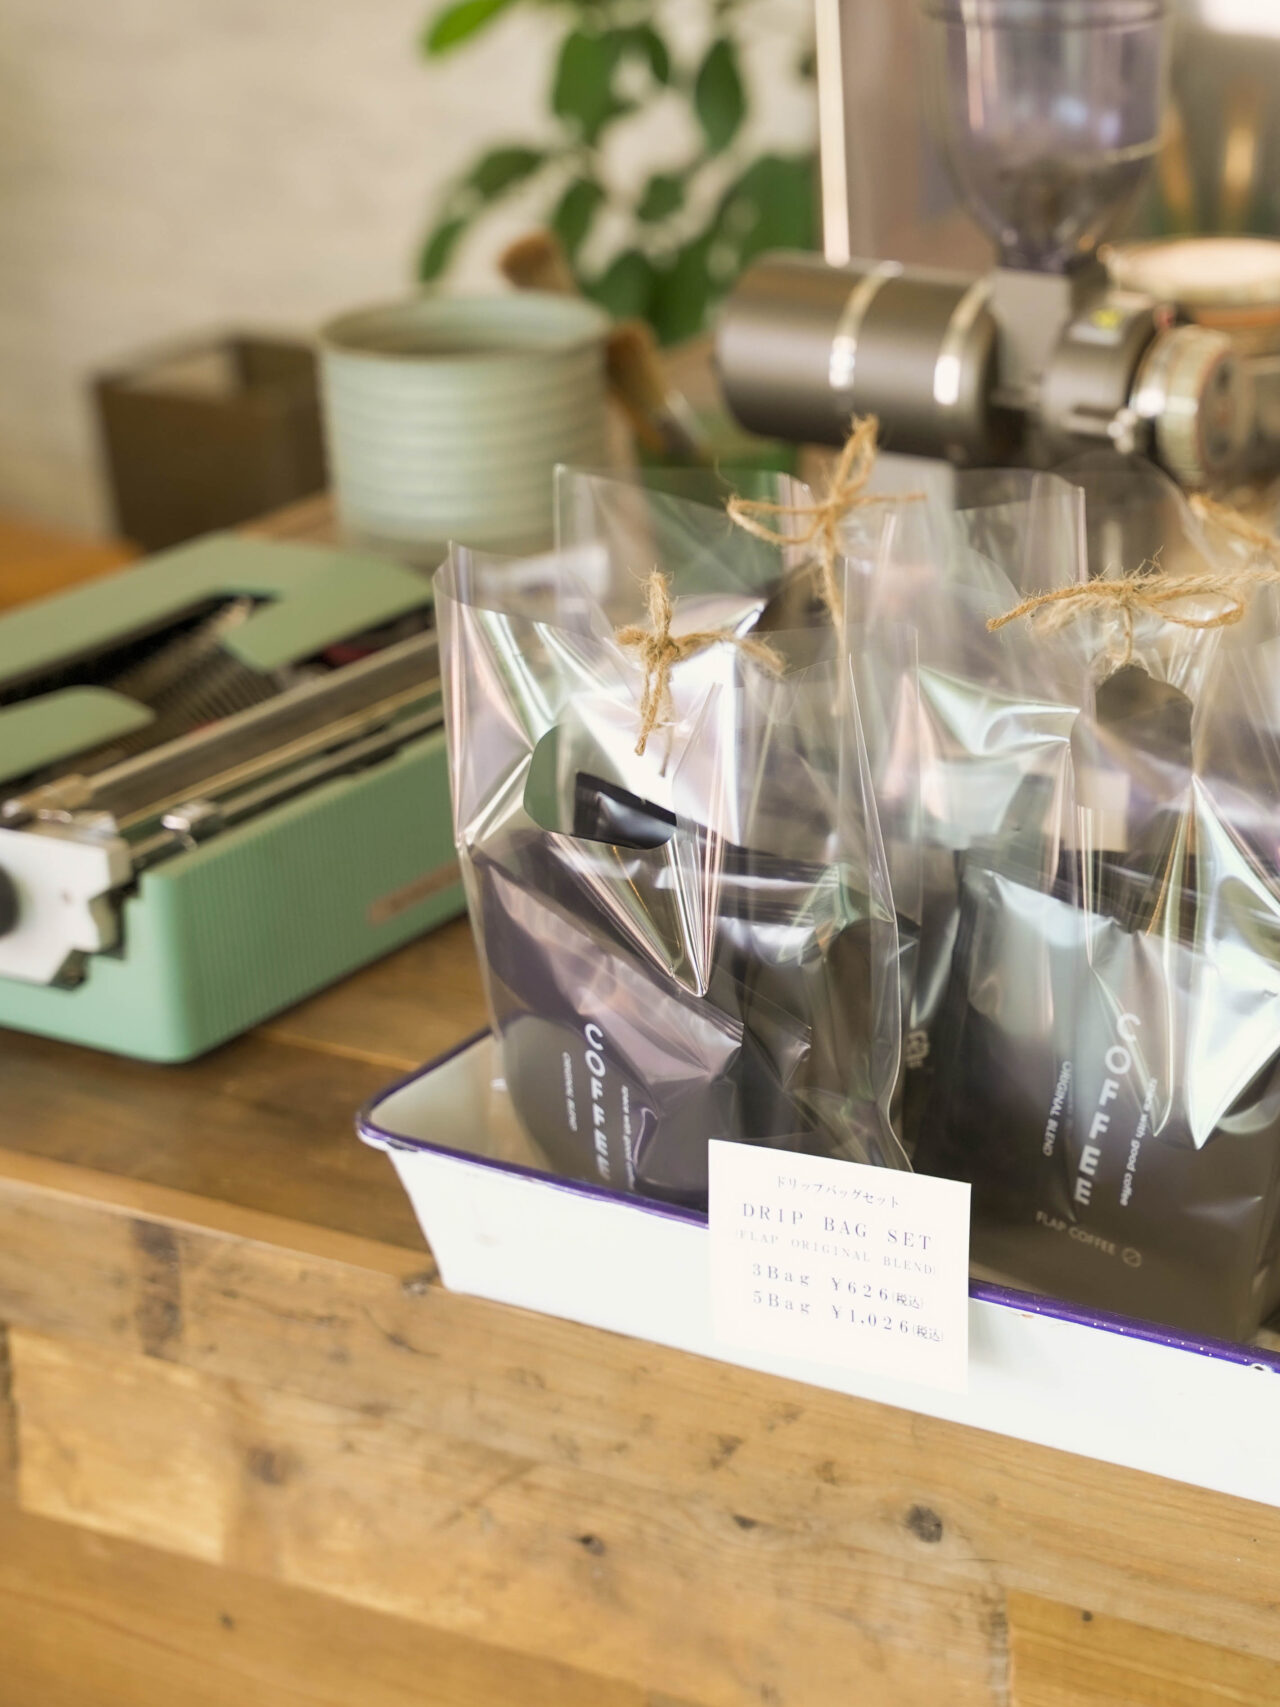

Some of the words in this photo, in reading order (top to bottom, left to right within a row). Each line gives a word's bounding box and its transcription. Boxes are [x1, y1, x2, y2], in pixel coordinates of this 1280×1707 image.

[584, 1023, 611, 1181] COFFEE
[1074, 1012, 1141, 1205] COFFEE
[1135, 1113, 1149, 1138] with
[1126, 1138, 1141, 1173] good
[777, 1175, 899, 1209] ドリップバッグセット
[1119, 1172, 1133, 1207] coffee
[742, 1202, 804, 1225] DRIP
[823, 1215, 868, 1238] BAG
[887, 1228, 932, 1251] SET
[790, 1237, 871, 1264] ORIGINAL
[752, 1263, 810, 1287] 3Bag
[753, 1290, 811, 1315] 5Bag
